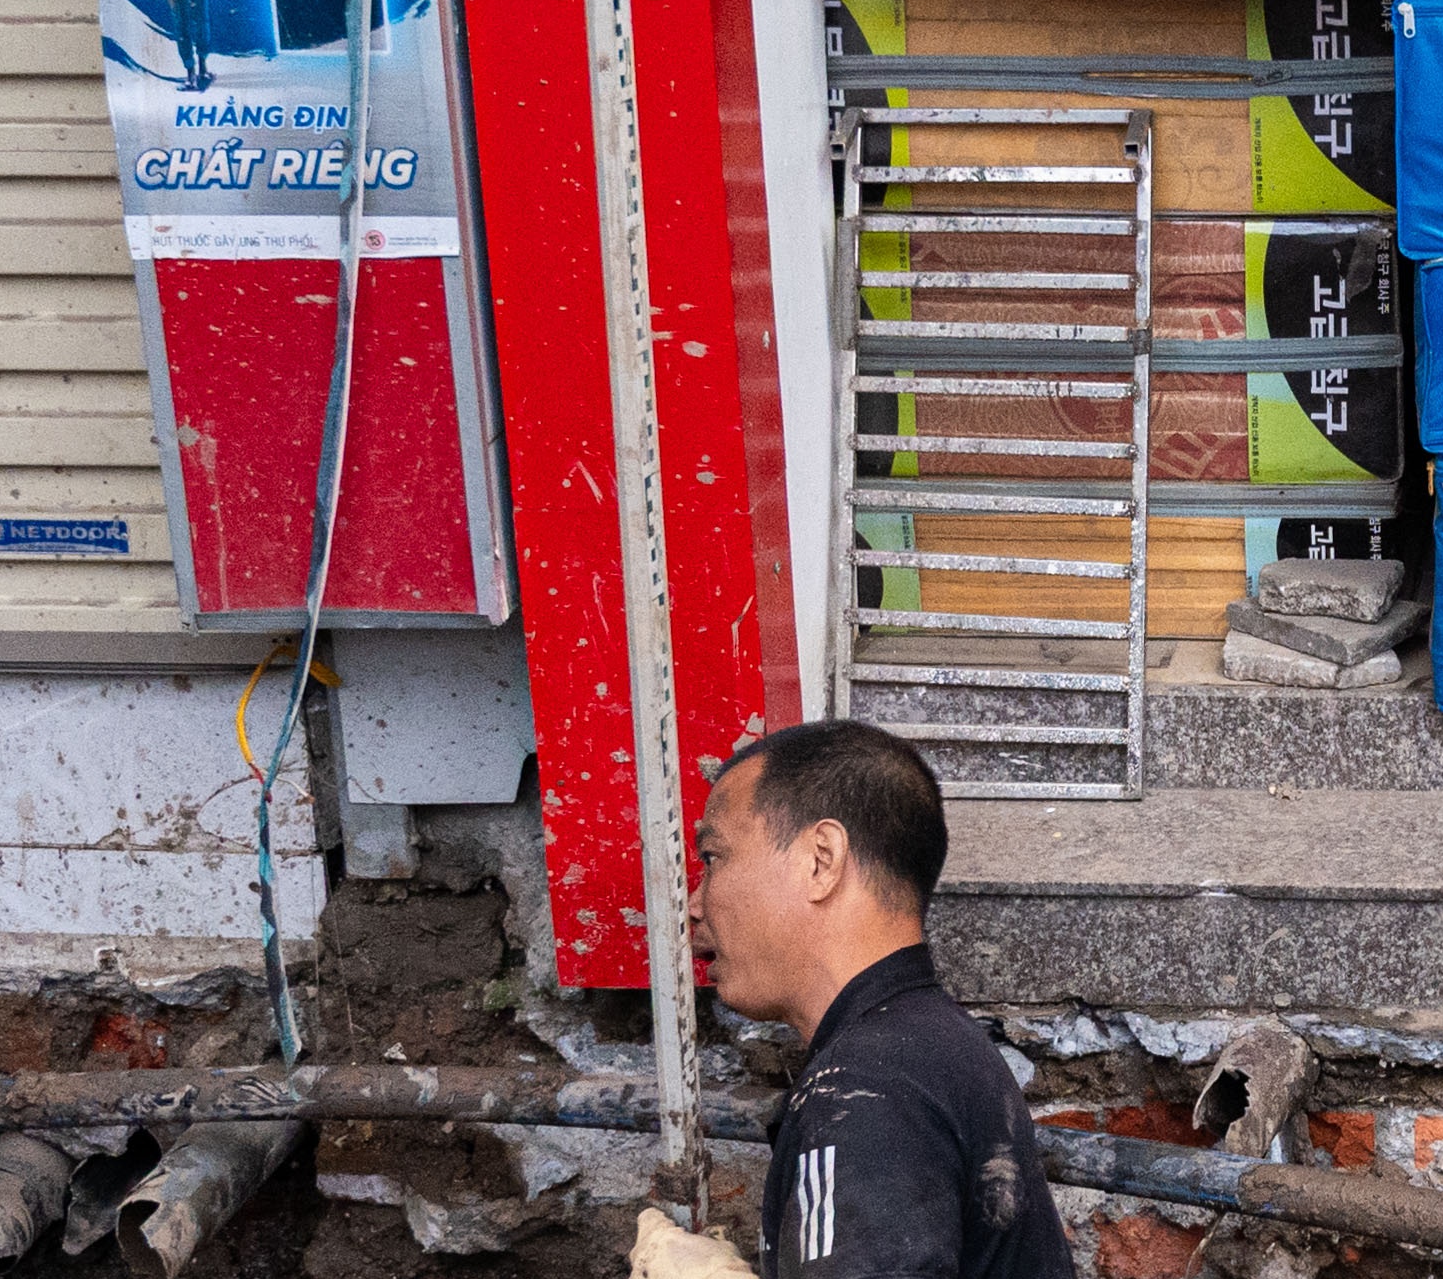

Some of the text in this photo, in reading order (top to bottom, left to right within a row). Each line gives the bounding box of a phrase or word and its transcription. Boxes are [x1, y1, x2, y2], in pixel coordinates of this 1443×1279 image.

[175, 96, 370, 134] KHẲNG ĐỊN
[135, 137, 418, 190] CHẤT RIÊNG
[10, 525, 121, 541] NETDOOR
